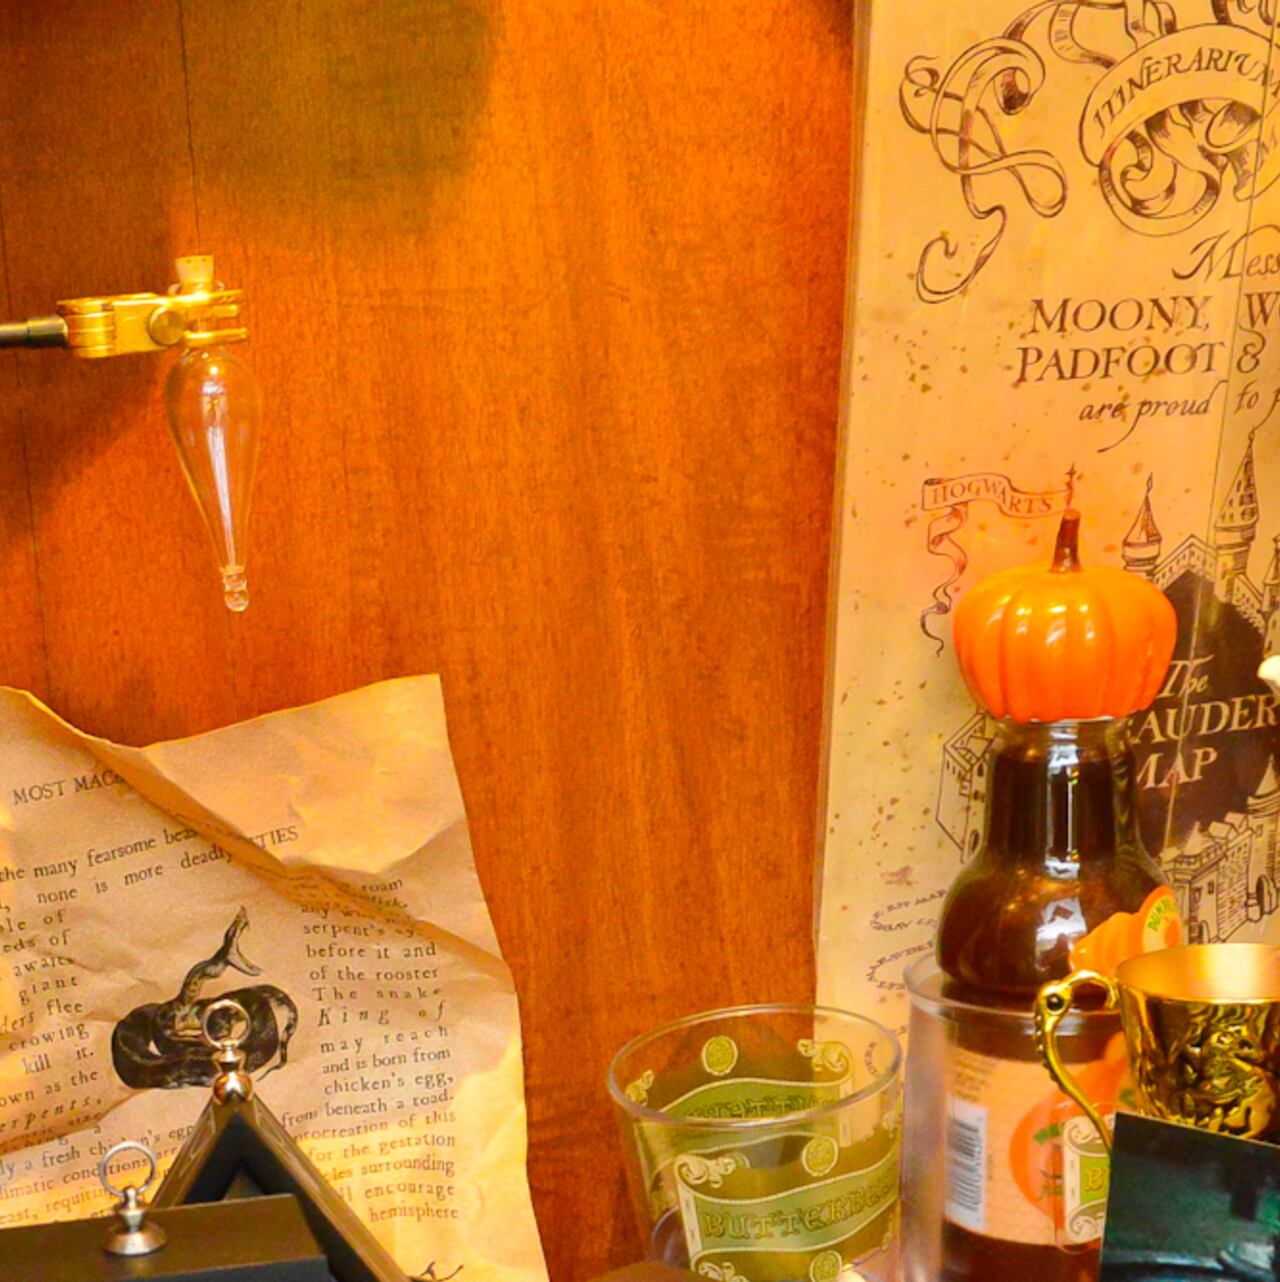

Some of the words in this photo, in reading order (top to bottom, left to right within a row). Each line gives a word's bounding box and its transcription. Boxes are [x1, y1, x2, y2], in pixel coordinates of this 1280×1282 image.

[1027, 294, 1213, 334] MOONY,
[1016, 341, 1224, 382] PADFOOT
[1236, 326, 1266, 374] &
[1236, 380, 1259, 413] to
[1078, 400, 1125, 422] are
[1097, 380, 1228, 453] proud
[931, 478, 1053, 514] HOGWARTS
[1157, 654, 1214, 698] The
[1136, 746, 1218, 790] MAP
[12, 780, 66, 805] MOST
[33, 859, 78, 878] many
[87, 836, 156, 867] fearsome
[37, 886, 78, 904] none
[94, 876, 108, 893] is
[124, 863, 164, 886] more
[42, 908, 67, 925] of
[49, 928, 72, 946] of
[306, 941, 367, 959] before
[376, 942, 390, 959] it
[403, 941, 437, 958] and
[309, 965, 329, 981] of
[337, 965, 366, 981] the
[376, 968, 439, 981] rooster
[19, 975, 80, 1006] giant
[312, 986, 358, 1002] The
[376, 985, 443, 1000] snake
[46, 998, 83, 1017] flee
[317, 1007, 390, 1027] King
[418, 999, 446, 1022] of
[8, 1022, 90, 1051] crowing
[320, 1036, 364, 1054] may
[383, 1025, 449, 1044] reach
[22, 1052, 52, 1075] kill
[322, 1058, 350, 1074] and
[355, 1058, 368, 1071] is
[372, 1053, 407, 1068] born
[412, 1047, 451, 1063] from
[45, 1081, 61, 1096] as
[70, 1069, 98, 1087] the
[324, 1071, 405, 1095] chicken's
[414, 1071, 454, 1090] egg,
[282, 1112, 317, 1129] from
[325, 1098, 388, 1118] beneath
[395, 1100, 404, 1110] a
[412, 1089, 455, 1107] toad.
[397, 1113, 419, 1129] of
[425, 1110, 457, 1125] this
[25, 1159, 33, 1170] a
[41, 1145, 81, 1168] fresh
[308, 1146, 332, 1162] for
[343, 1143, 371, 1159] the
[378, 1132, 456, 1156] gestation
[361, 1153, 456, 1178] surrounding
[364, 1181, 455, 1202] encourage
[369, 1201, 459, 1223] hemisphere
